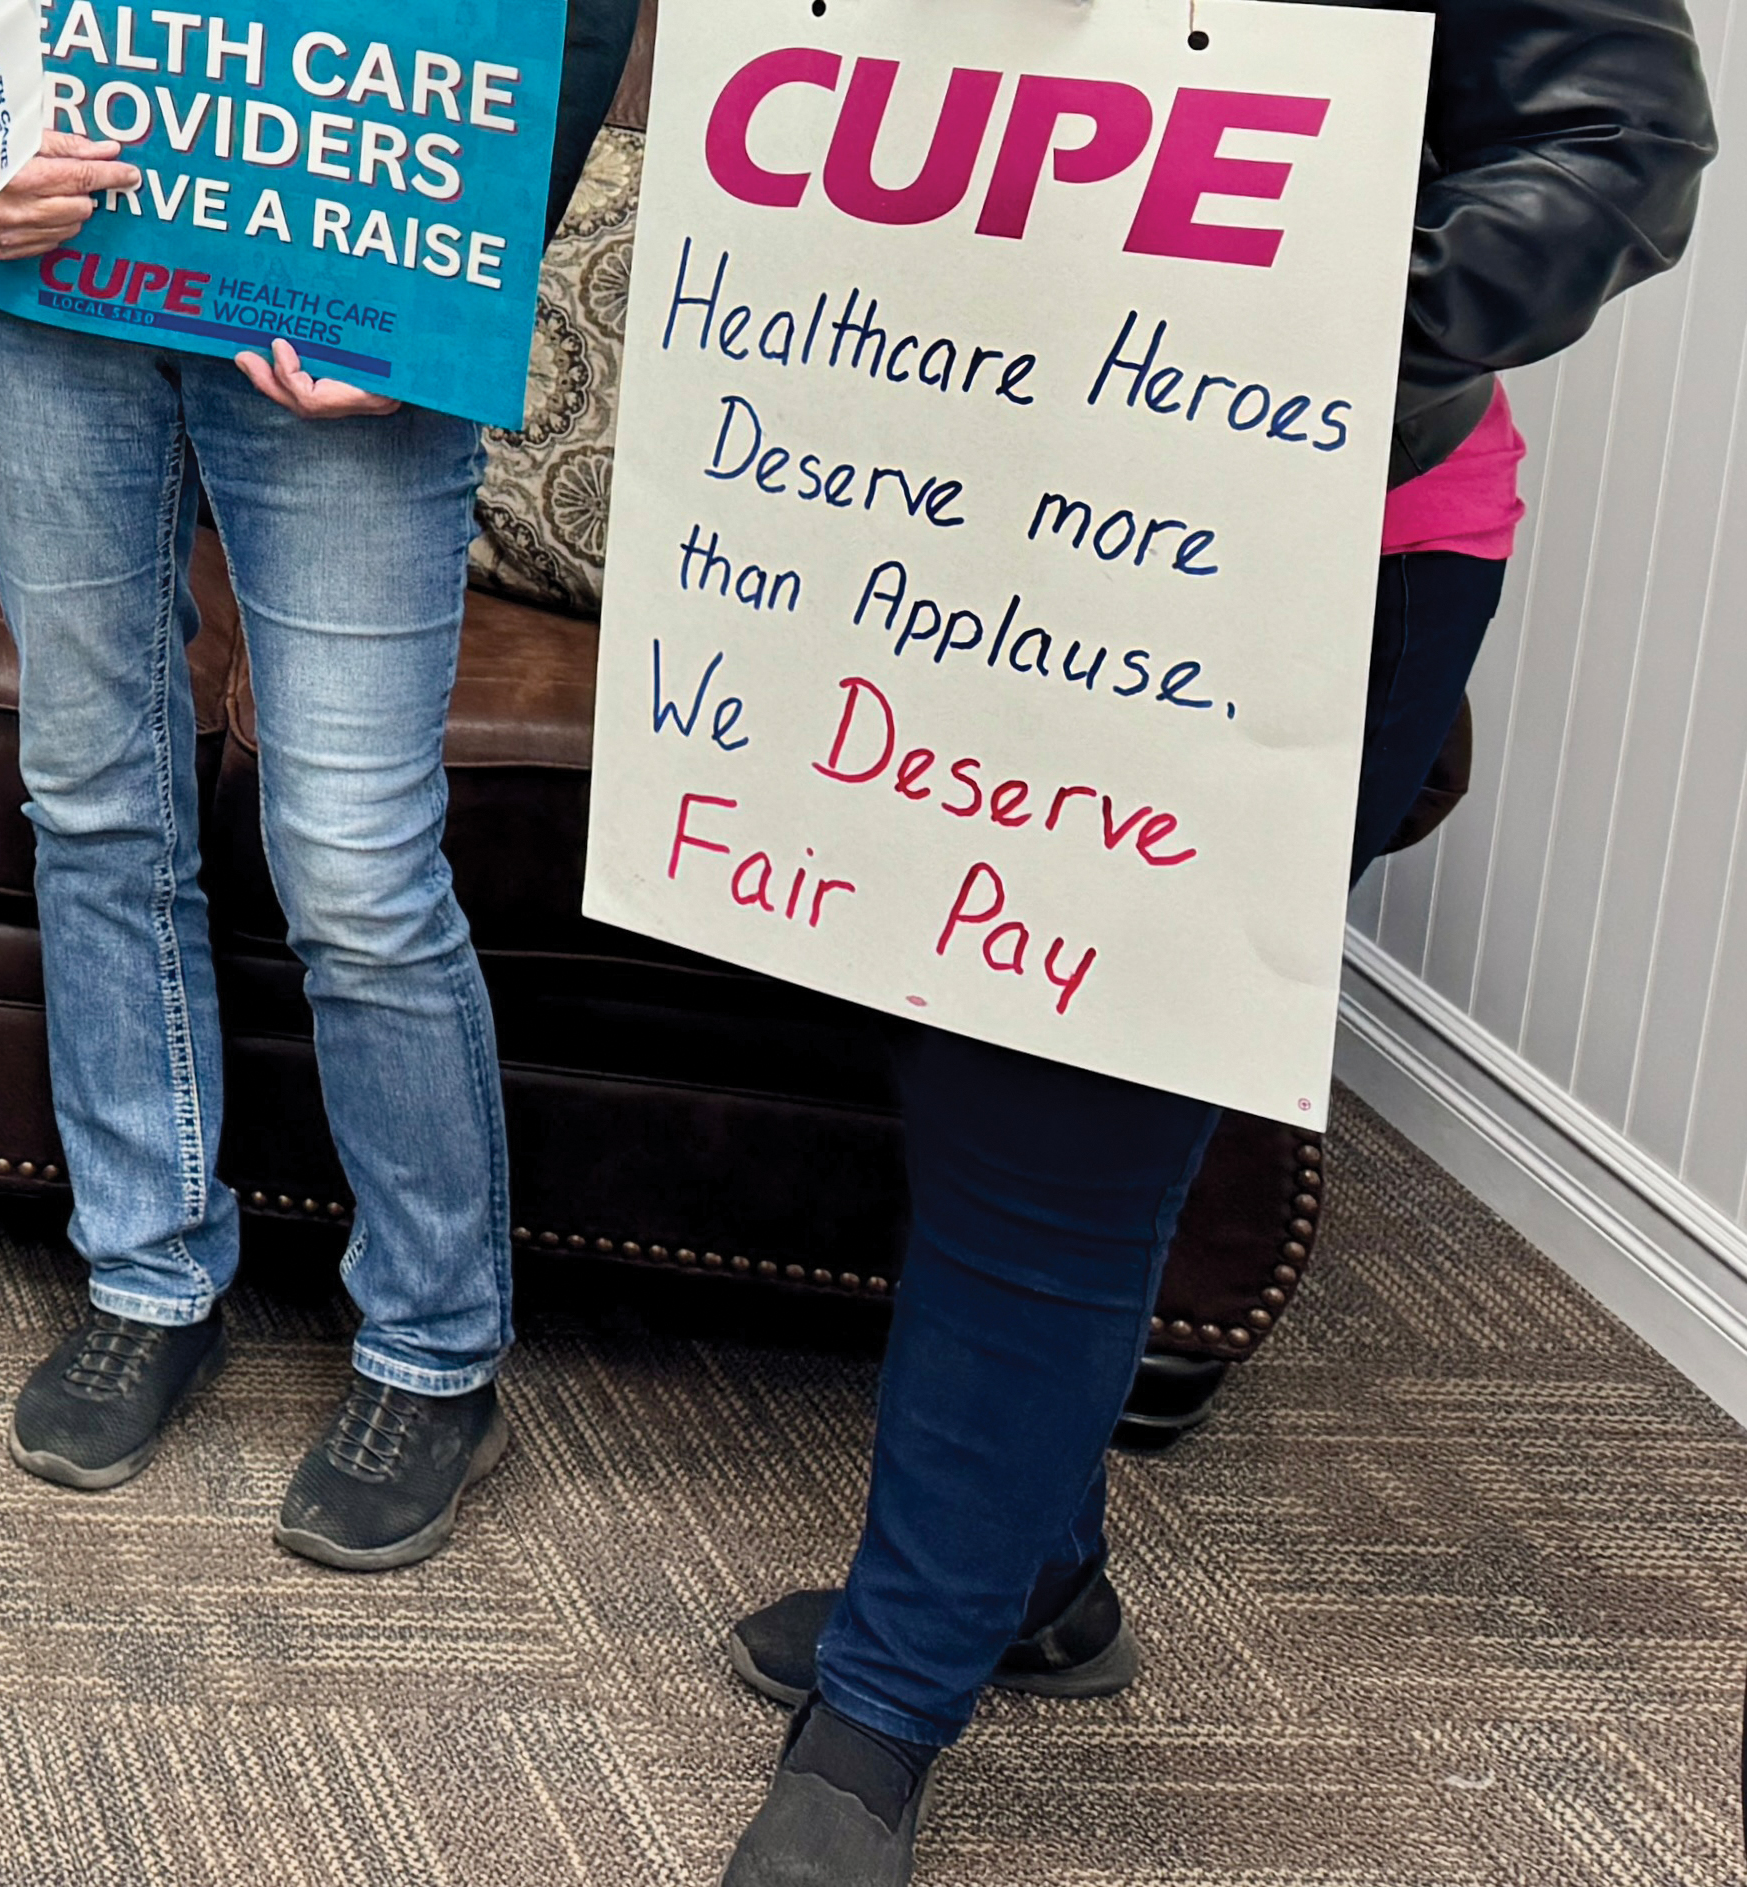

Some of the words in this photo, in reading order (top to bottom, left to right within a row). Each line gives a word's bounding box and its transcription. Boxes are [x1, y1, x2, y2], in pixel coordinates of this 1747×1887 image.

[291, 31, 519, 134] CARE
[704, 47, 1332, 268] CUPE
[39, 248, 211, 316] CUPE
[52, 296, 105, 318] LOCAL
[218, 277, 320, 311] HEALTH
[326, 299, 397, 334] CARE
[244, 189, 291, 245] A
[311, 197, 507, 290] RAISE
[213, 301, 343, 346] WORKERS
[661, 237, 1035, 404] Healthcare
[1087, 310, 1352, 453] Heroes
[703, 395, 966, 529] Deserve
[1027, 490, 1219, 577] more
[679, 524, 801, 612] than
[853, 560, 1238, 719] Applause.
[651, 639, 749, 752] We
[812, 676, 1197, 867] Deserve
[668, 792, 855, 928] Fair
[935, 861, 1098, 1015] Pay
